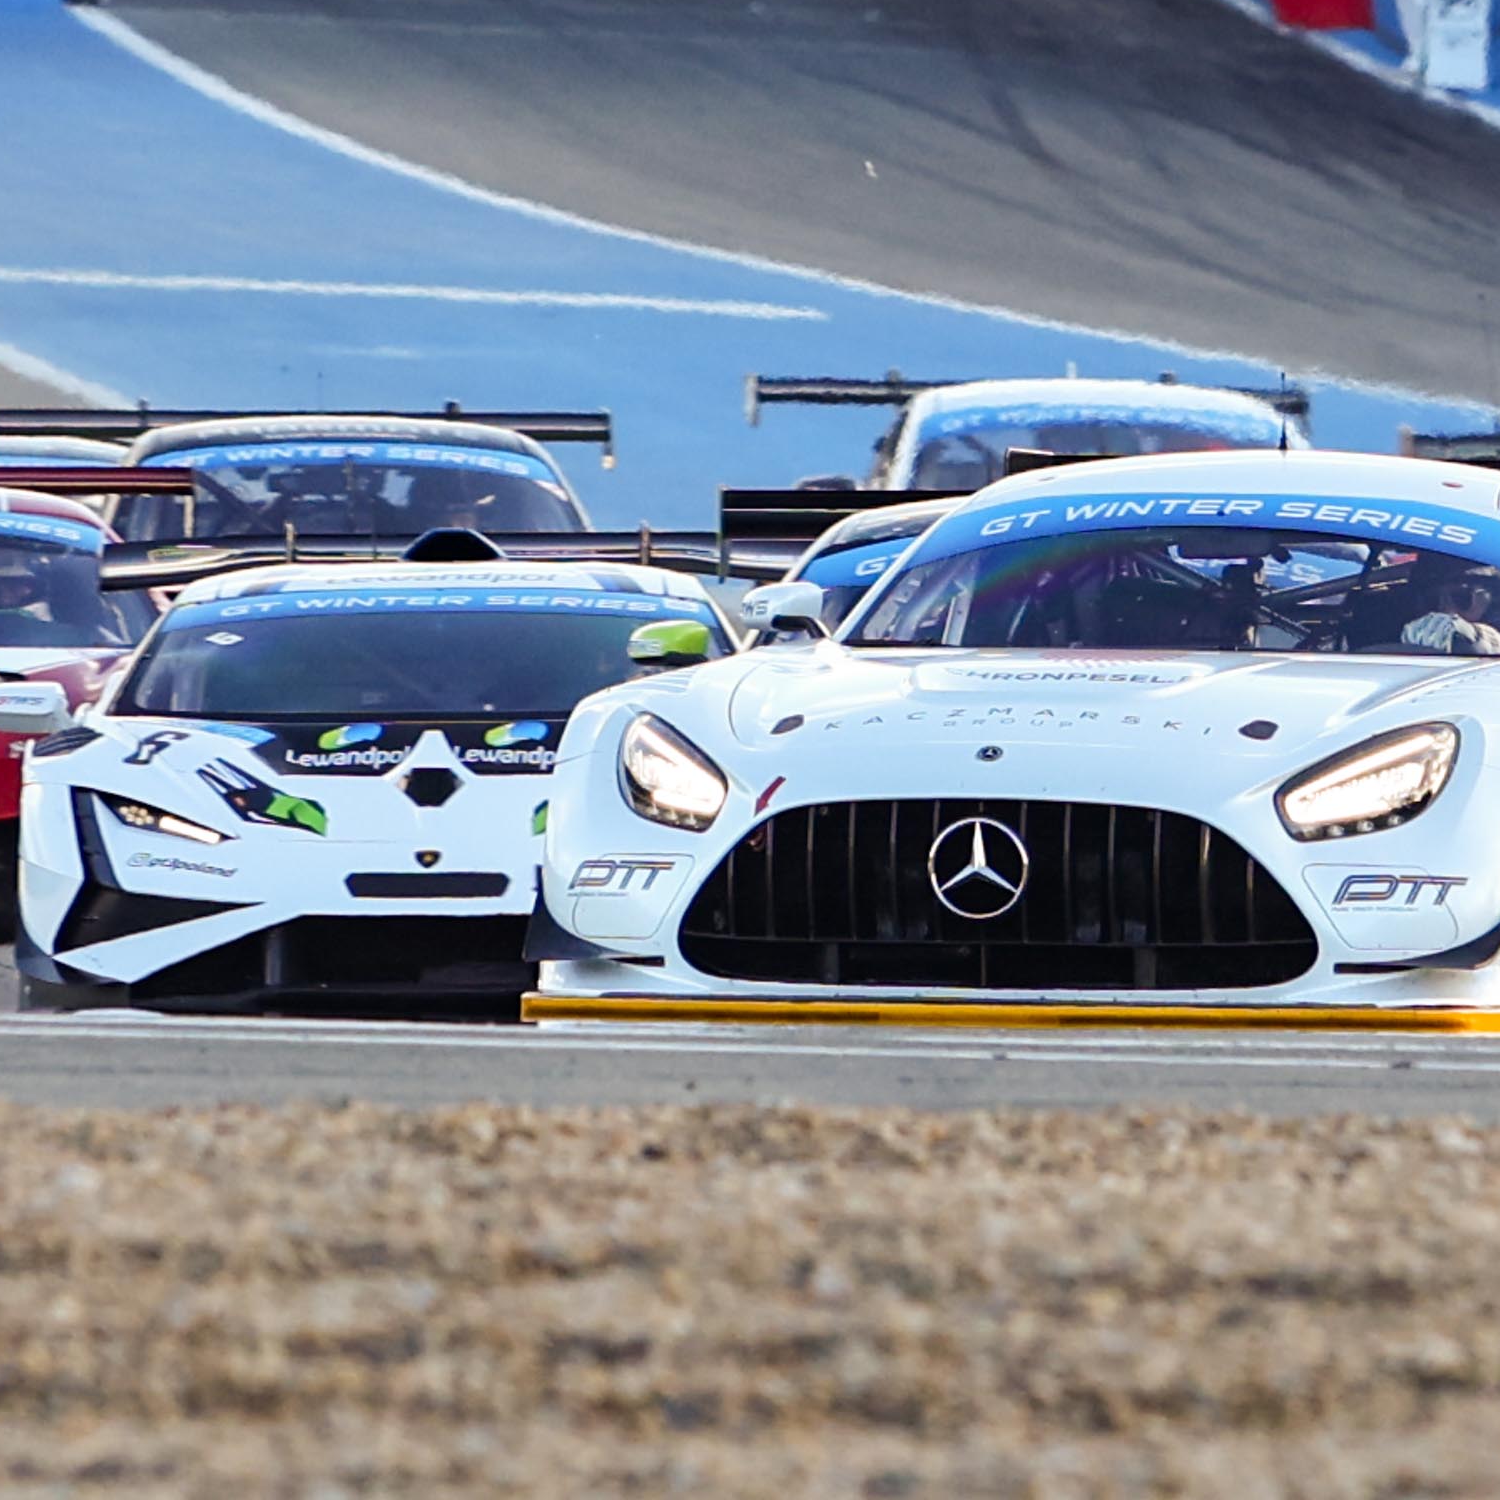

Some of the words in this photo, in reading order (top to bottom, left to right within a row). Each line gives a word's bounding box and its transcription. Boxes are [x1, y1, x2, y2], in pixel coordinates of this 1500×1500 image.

[226, 444, 376, 462] WINTER
[386, 445, 530, 476] SERIES
[979, 508, 1051, 538] GT
[1065, 497, 1265, 524] WINTER
[1273, 501, 1479, 546] SERIES
[219, 600, 286, 618] GT
[296, 594, 474, 611] WINTER
[484, 594, 658, 613] SERIES
[823, 707, 1212, 736] KACZMARSKI
[121, 730, 191, 766] 6
